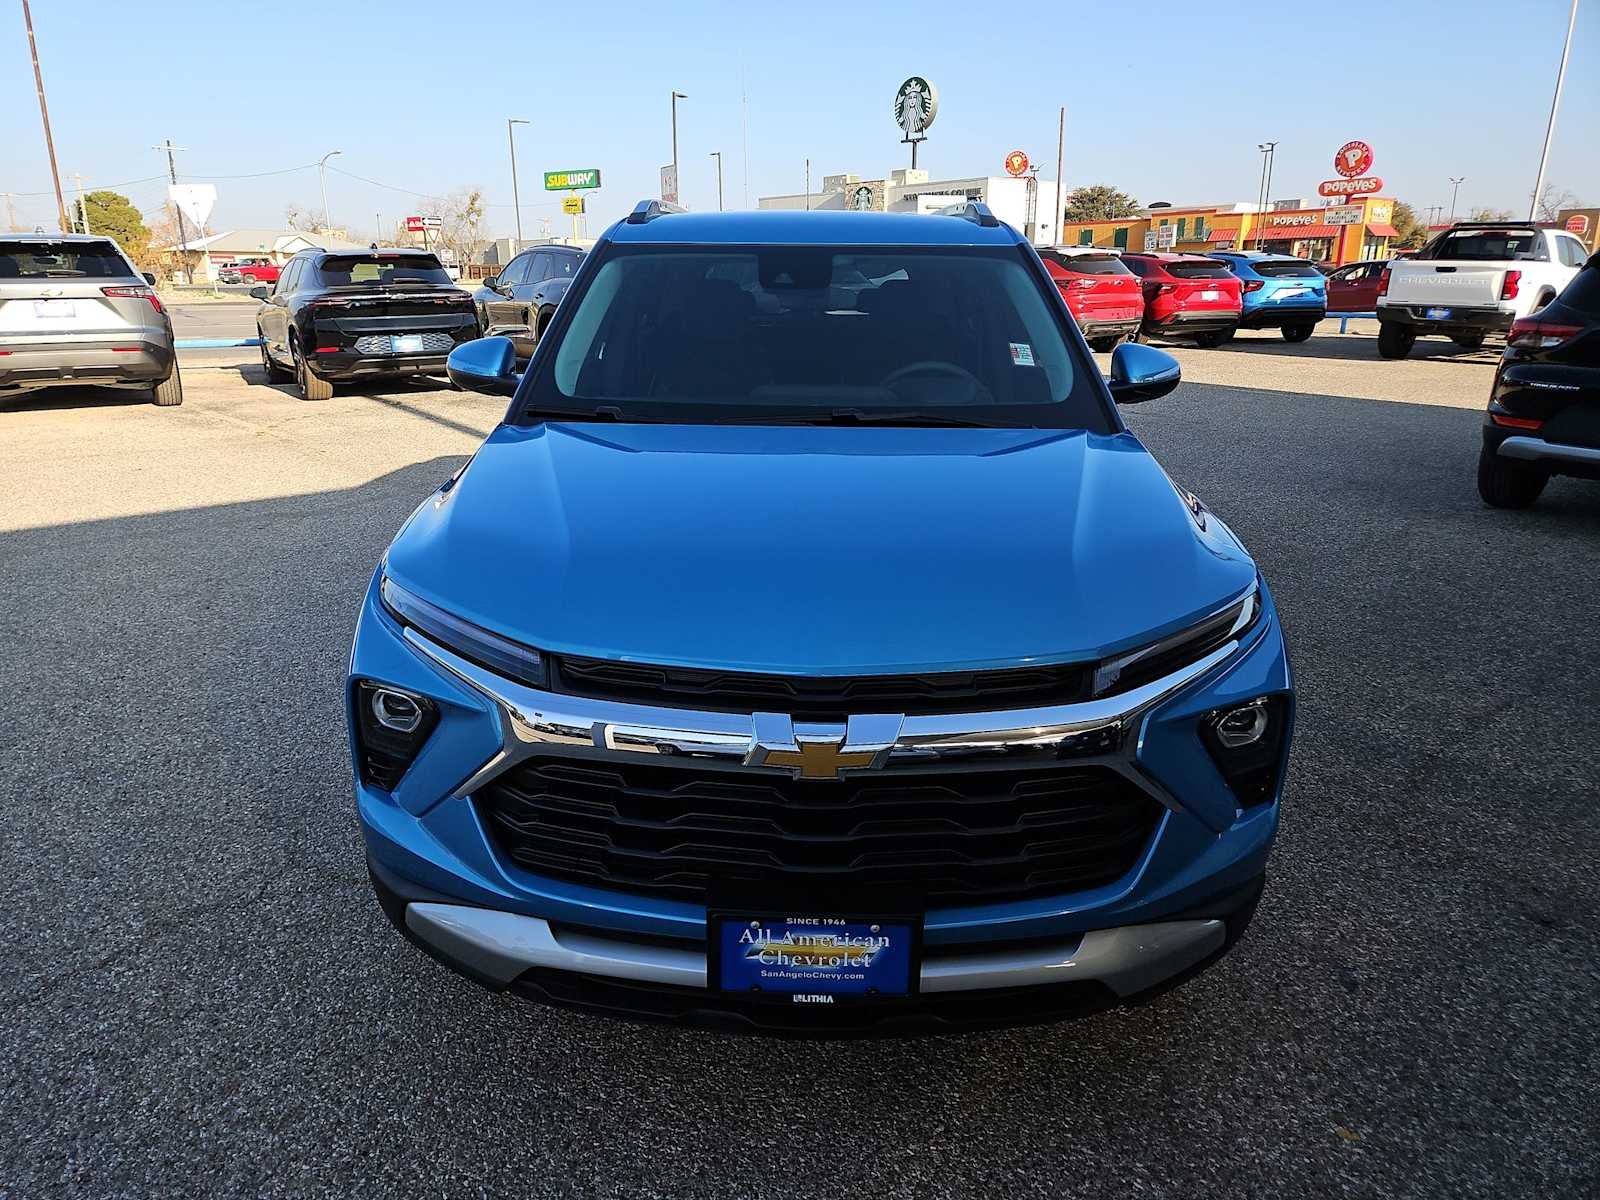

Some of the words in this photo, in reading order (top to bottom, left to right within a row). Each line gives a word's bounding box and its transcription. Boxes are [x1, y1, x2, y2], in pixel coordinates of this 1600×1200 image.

[1345, 149, 1362, 168] P
[546, 172, 592, 187] SUBWAY
[1399, 276, 1489, 288] CHEVROLET
[786, 917, 819, 926] SINCE
[822, 918, 846, 926] 1946
[738, 928, 771, 945] All
[781, 931, 890, 948] American
[758, 949, 872, 968] Chevrolet
[760, 970, 865, 981] SanAngeloChevy.com
[802, 994, 834, 1004] LITHIA
